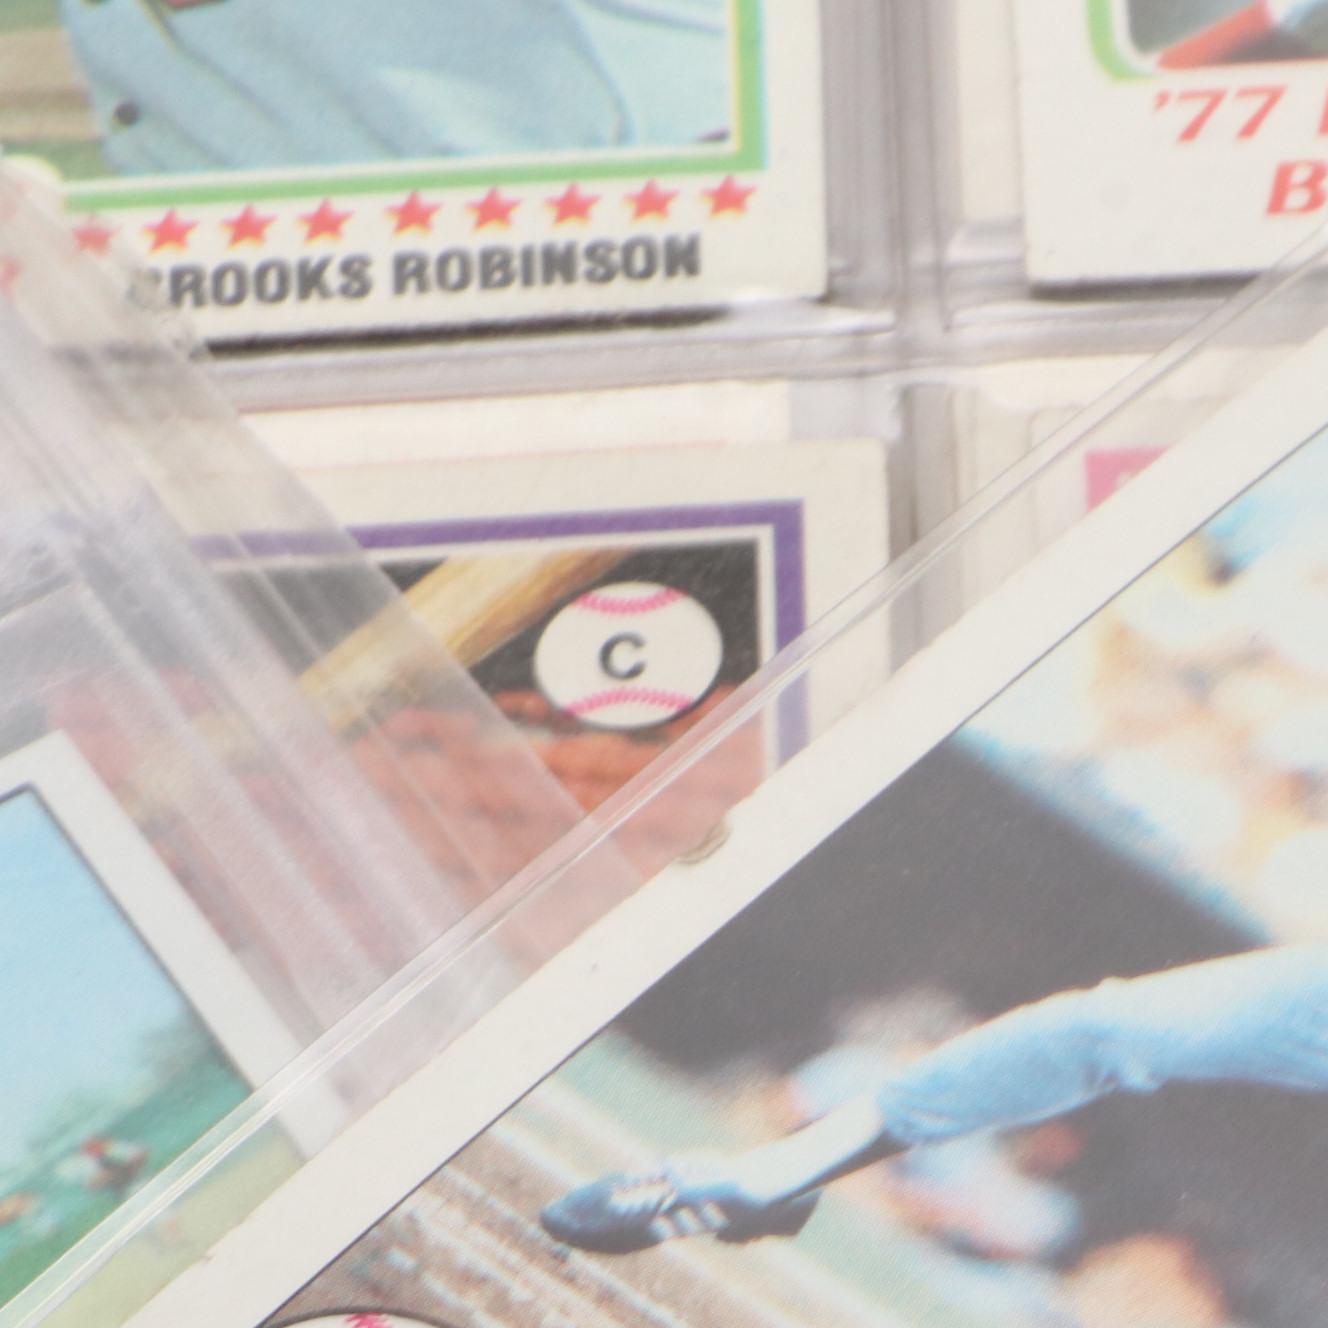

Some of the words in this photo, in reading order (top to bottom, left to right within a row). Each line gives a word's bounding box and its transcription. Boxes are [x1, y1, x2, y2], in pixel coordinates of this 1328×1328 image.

[1153, 83, 1289, 145] '77
[391, 233, 704, 295] ROBINSON
[599, 630, 647, 682] C
